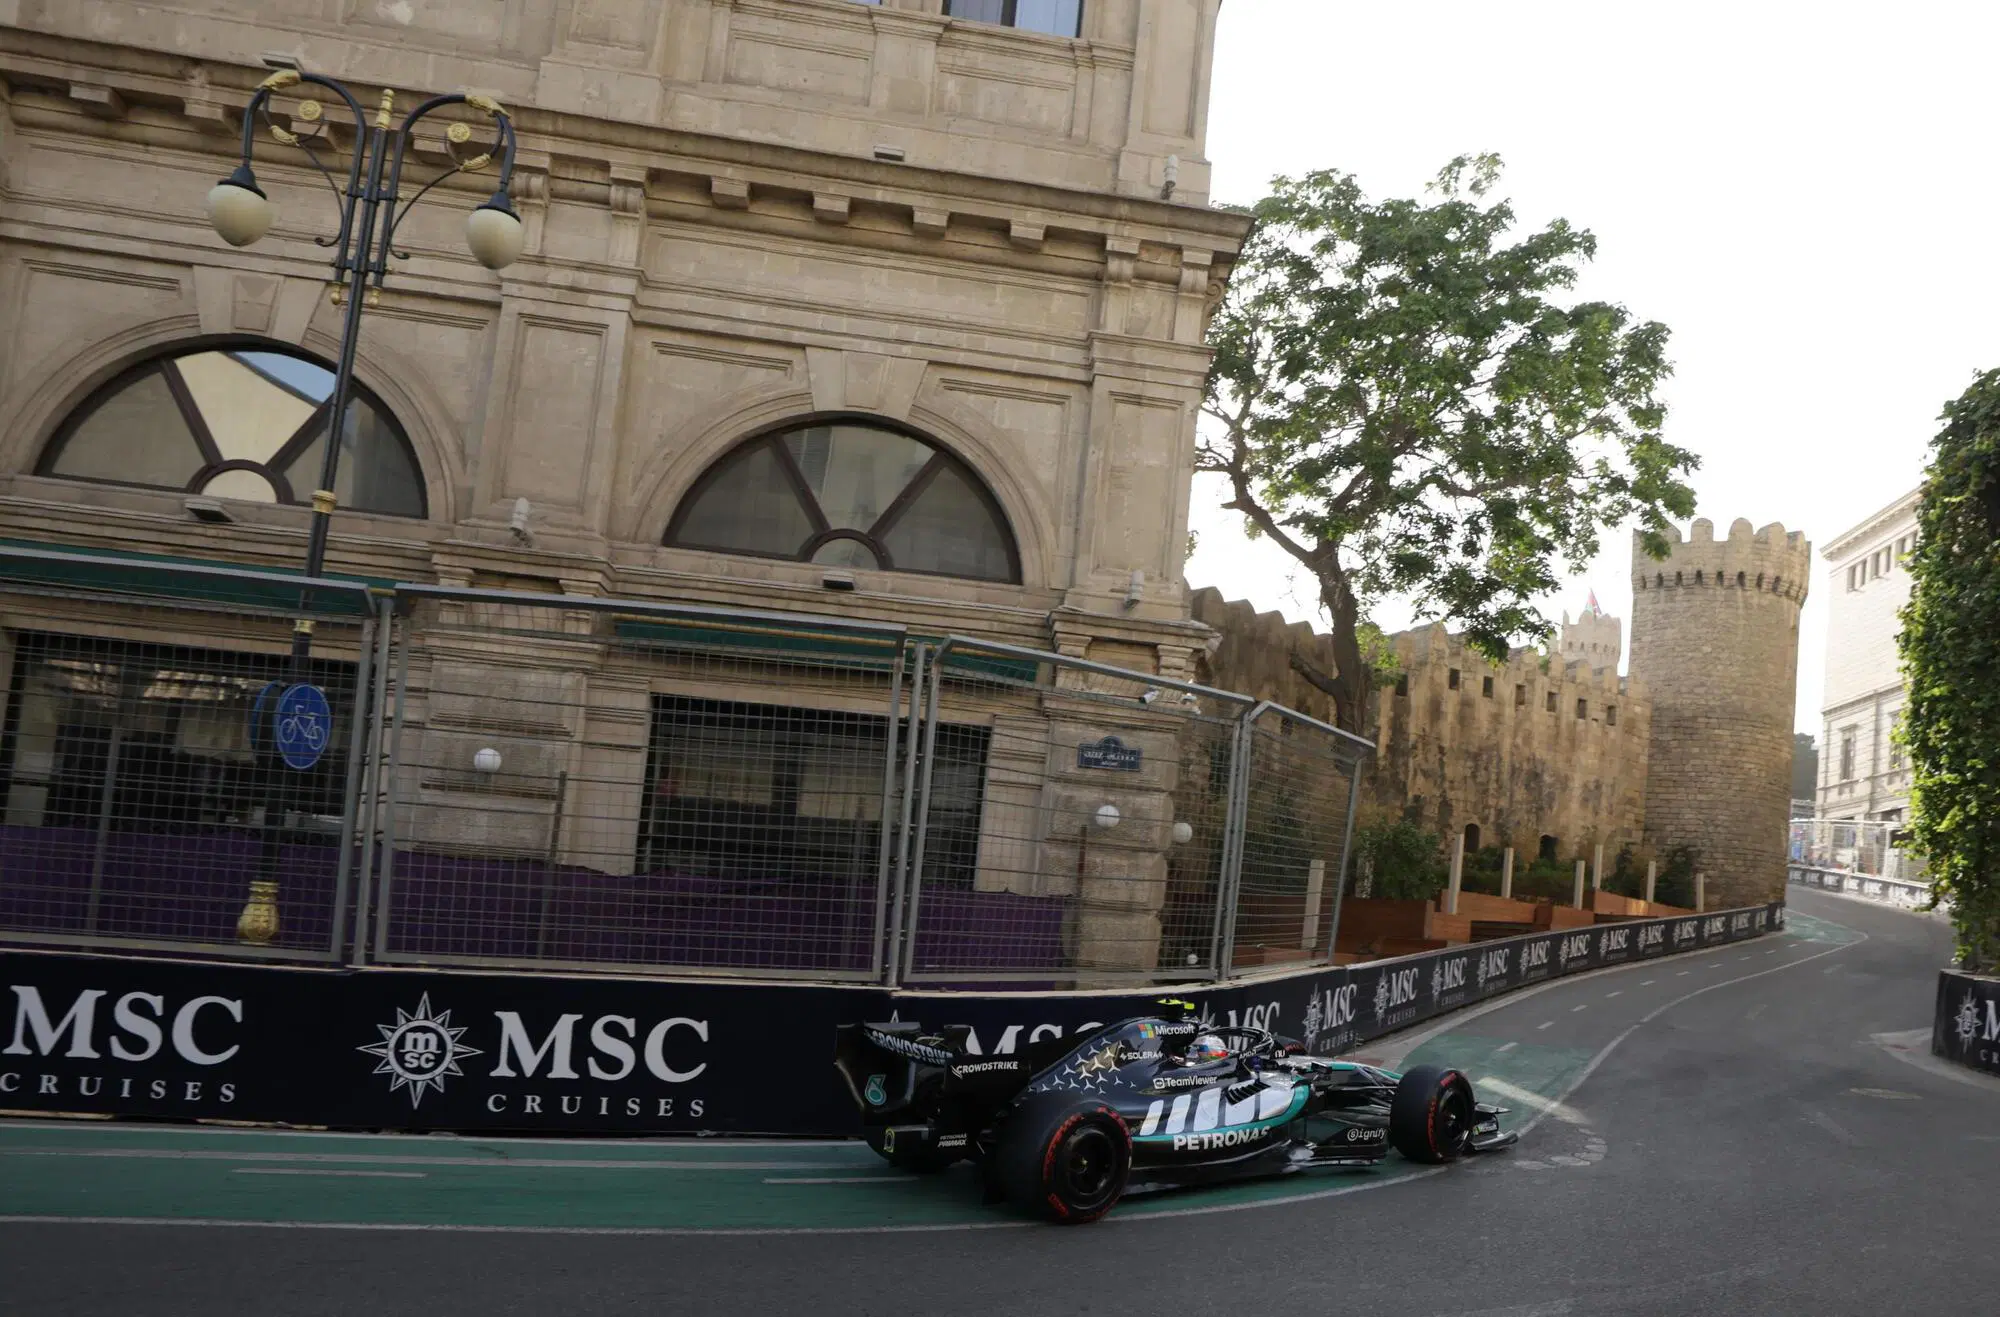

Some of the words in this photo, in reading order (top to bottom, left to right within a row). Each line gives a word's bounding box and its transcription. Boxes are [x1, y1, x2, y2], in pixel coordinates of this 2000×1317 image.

[1529, 940, 1551, 967] MSC
[1568, 934, 1590, 958] MSC
[1442, 957, 1468, 990] MSC
[1487, 947, 1510, 978] MSC
[1389, 967, 1419, 1007] MSC
[1321, 983, 1358, 1031] MSC
[3, 985, 243, 1065] MSC
[1155, 1024, 1195, 1035] Microsoft
[489, 1011, 709, 1083] MSC
[1127, 1050, 1157, 1060] SOLERA
[957, 1061, 1019, 1075] CROWDSTRIKE
[1164, 1076, 1217, 1087] TeamViewer
[0, 1072, 236, 1103] CRUISES
[487, 1094, 705, 1117] CRUISES
[1173, 1126, 1271, 1151] PETRONAS
